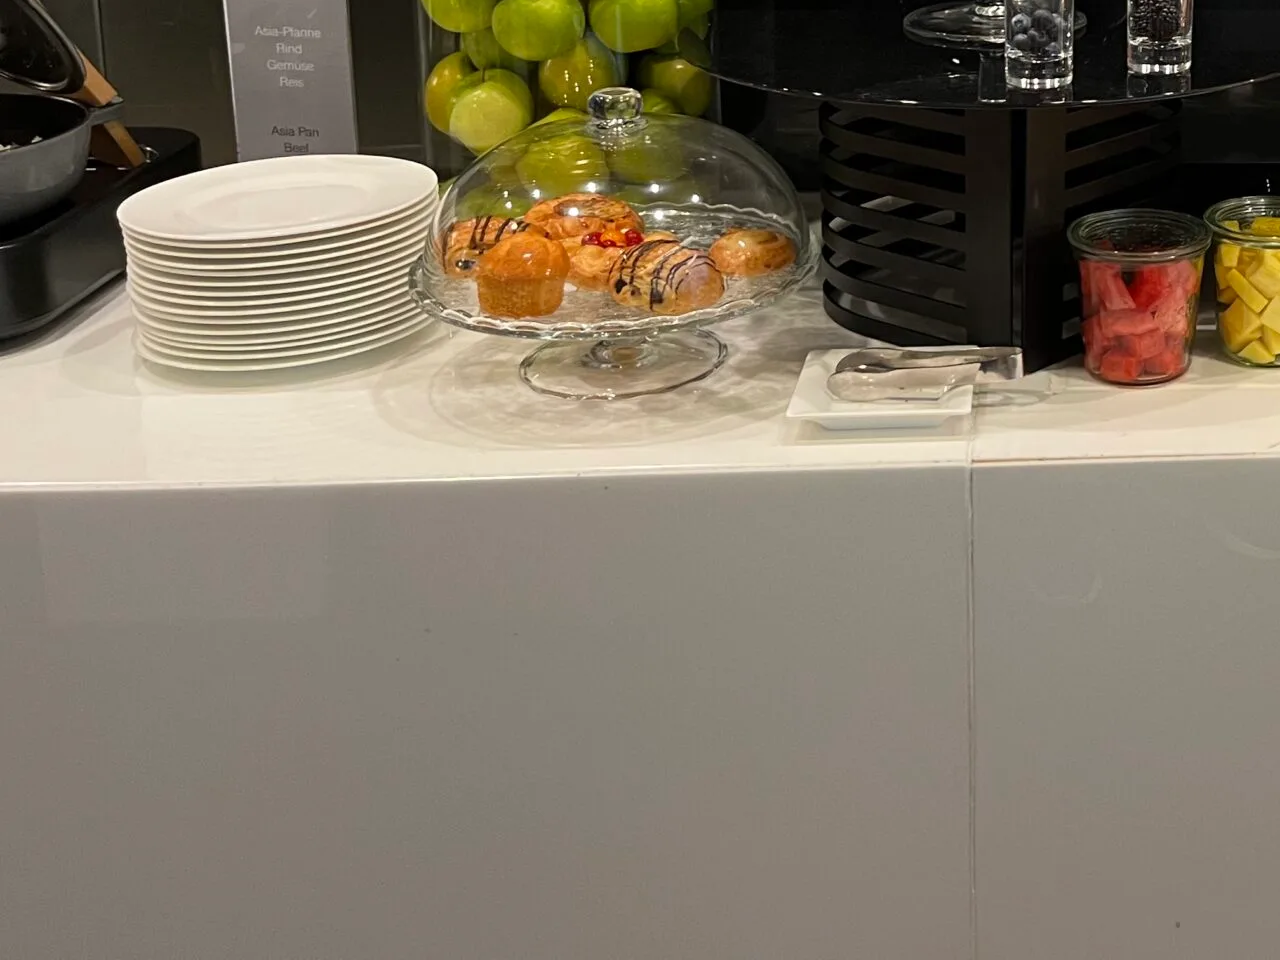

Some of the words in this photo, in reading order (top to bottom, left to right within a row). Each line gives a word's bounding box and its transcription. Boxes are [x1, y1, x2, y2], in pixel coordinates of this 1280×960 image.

[275, 42, 303, 54] Rind
[279, 76, 304, 88] Reis
[271, 125, 295, 136] Asia
[298, 126, 320, 137] Pan
